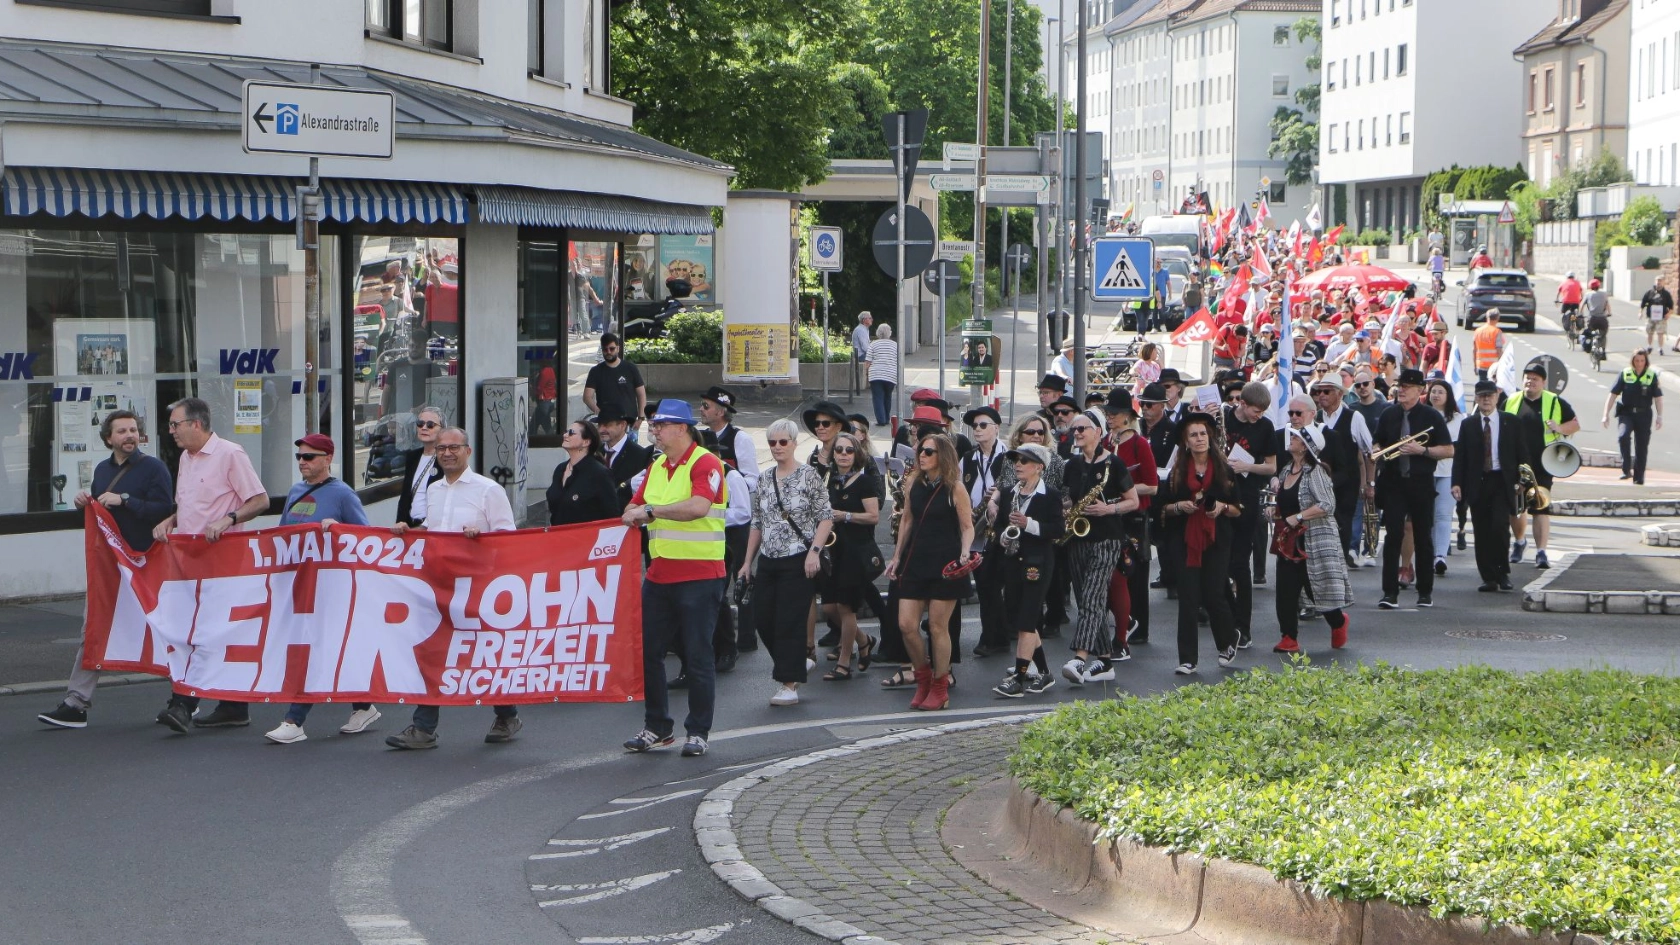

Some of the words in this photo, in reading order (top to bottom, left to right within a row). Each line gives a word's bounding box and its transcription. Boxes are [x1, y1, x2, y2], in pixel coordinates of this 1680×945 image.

[301, 113, 380, 133] Alexandrastraße
[219, 348, 280, 375] VdK
[338, 533, 426, 570] 2024
[594, 544, 617, 557] DGB
[449, 564, 622, 630] LOHN
[103, 562, 443, 694] MEHR
[445, 623, 615, 668] FREIZEIT
[439, 663, 611, 695] SICHERHEIT
